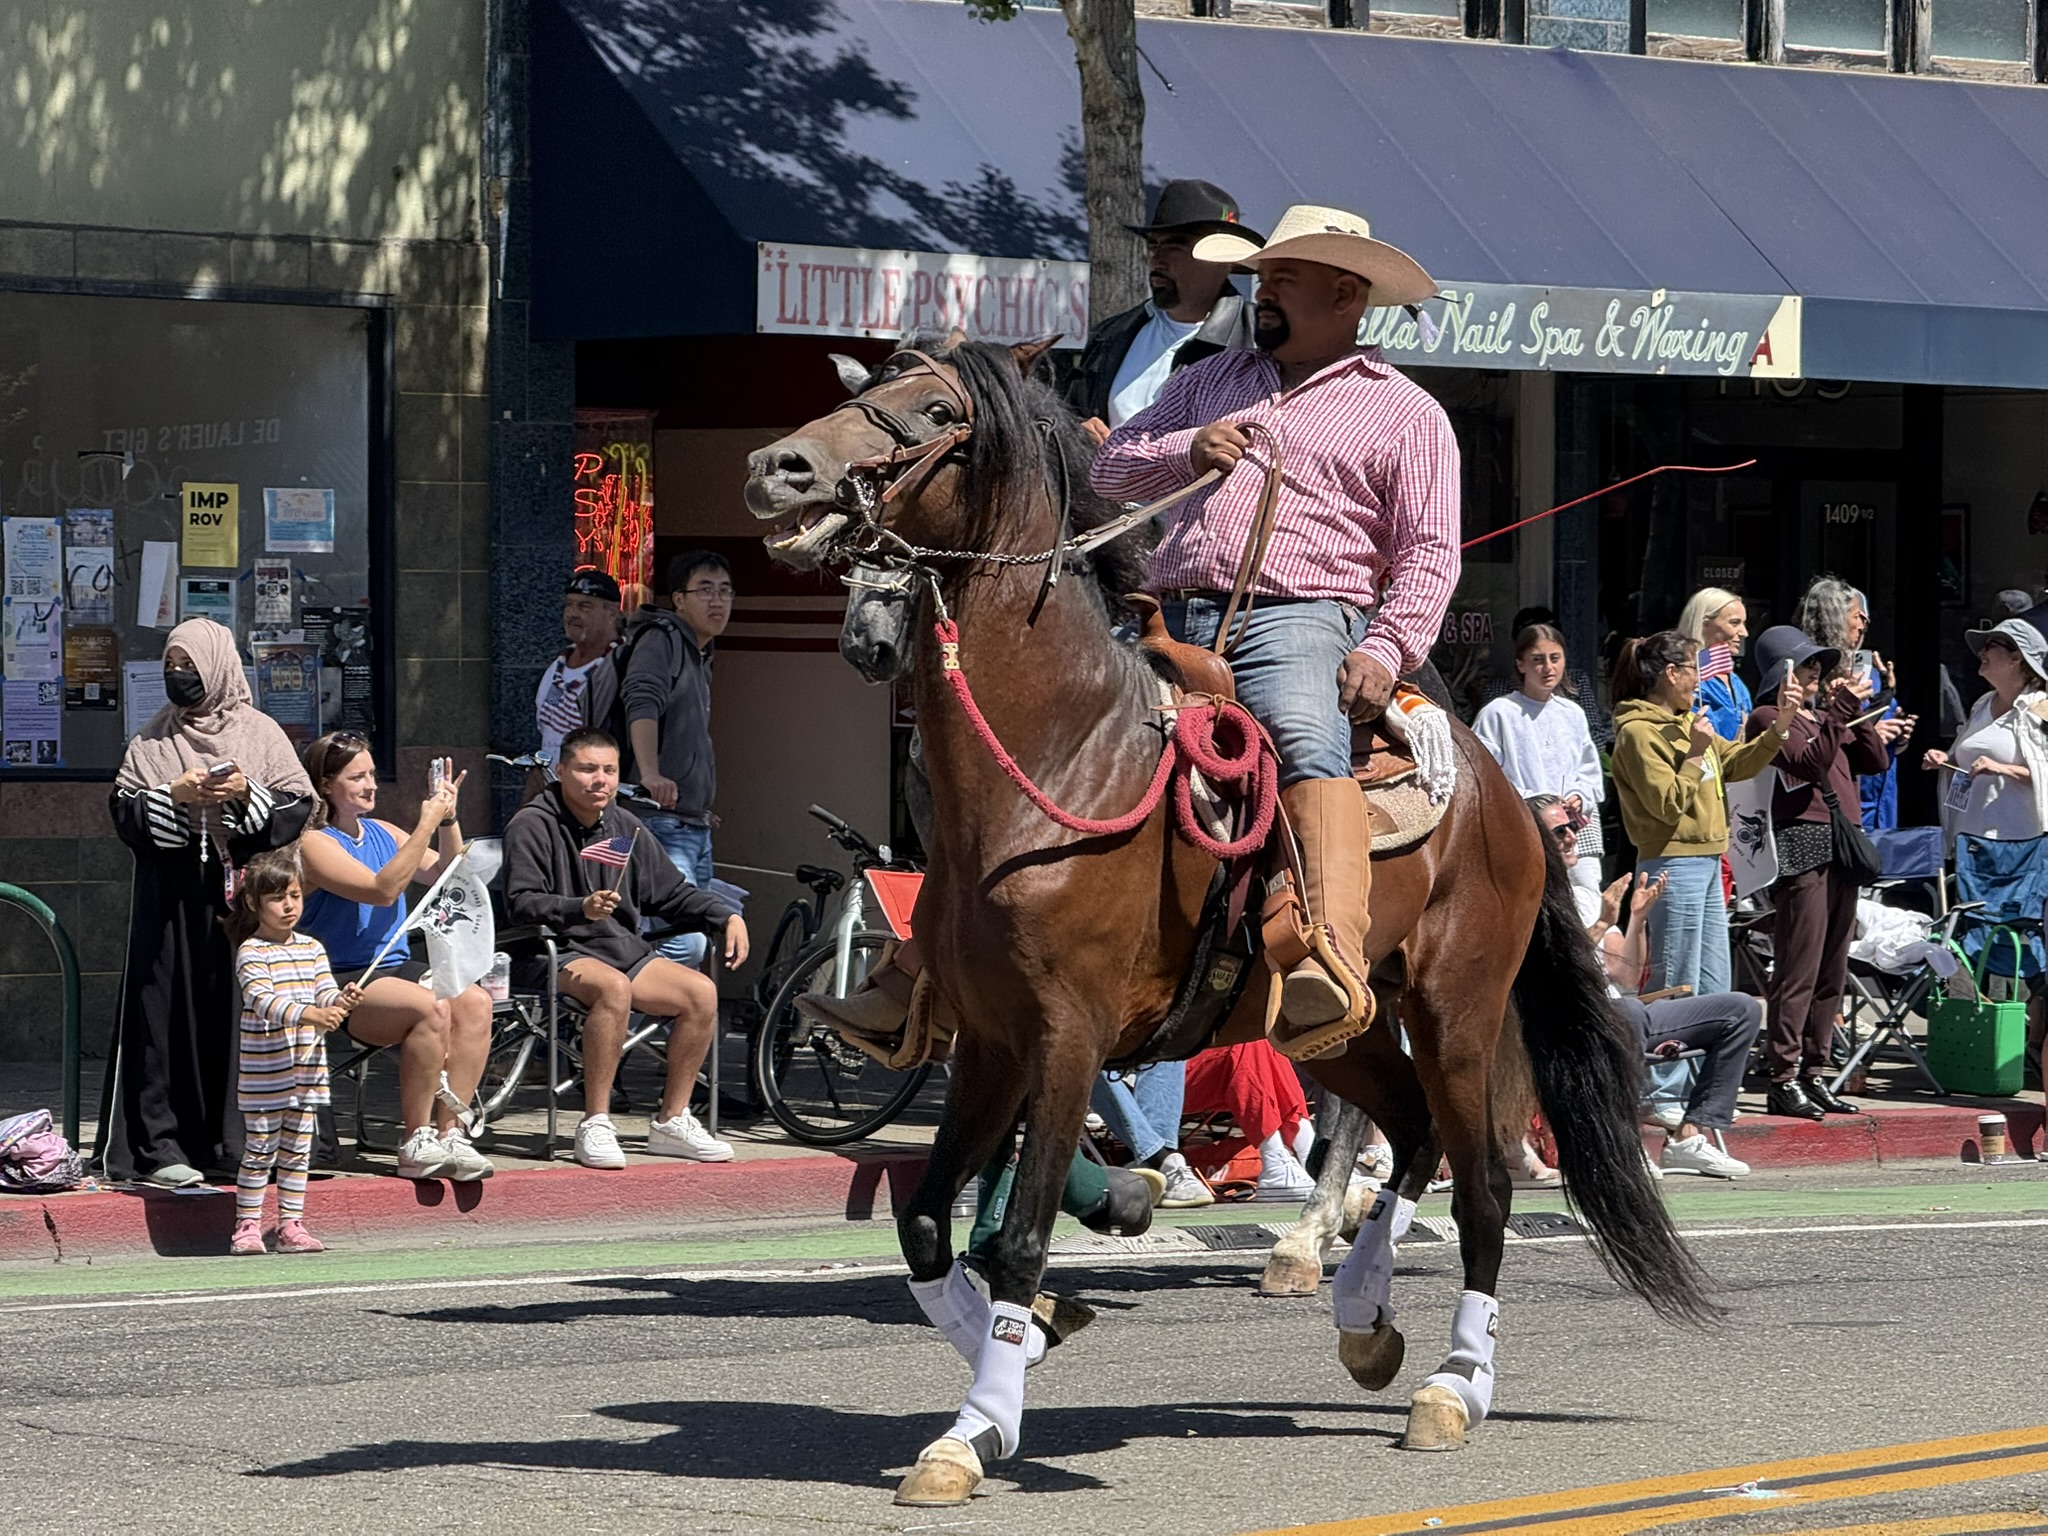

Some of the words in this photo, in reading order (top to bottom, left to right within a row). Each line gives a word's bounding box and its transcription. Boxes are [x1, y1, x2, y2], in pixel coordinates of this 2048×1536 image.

[775, 262, 902, 331] LITTLE
[1355, 305, 1420, 350] ella
[1423, 290, 1516, 355] Nail
[1520, 300, 1585, 367] Spa
[1596, 298, 1626, 358] &
[1629, 304, 1749, 376] Waxing
[190, 491, 229, 509] IMP
[573, 453, 603, 572] PSY
[1824, 503, 1859, 524] 1409
[189, 513, 224, 526] ROV
[1702, 567, 1740, 579] CLOSED
[1443, 611, 1458, 644] &
[1461, 612, 1493, 644] SPA
